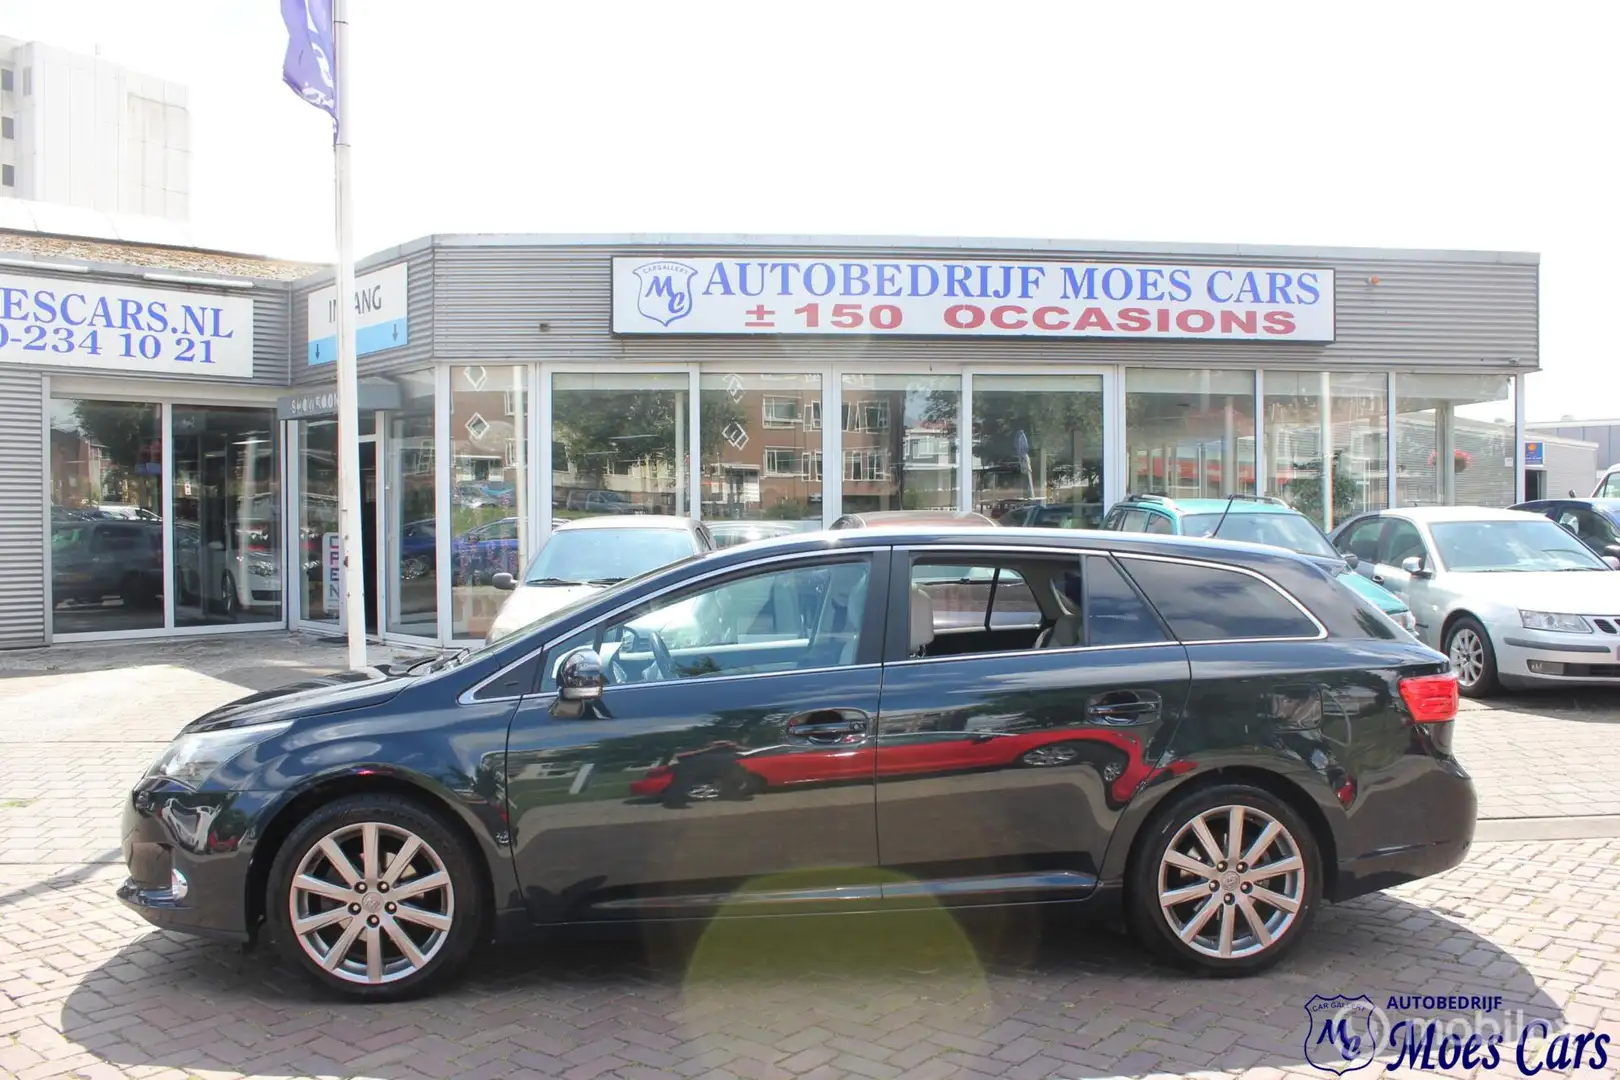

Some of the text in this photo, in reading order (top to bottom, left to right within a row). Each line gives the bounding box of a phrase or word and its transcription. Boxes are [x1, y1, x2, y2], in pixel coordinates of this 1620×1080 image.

[328, 284, 382, 323] IANG
[702, 262, 1321, 306] AUTOBEDRIJF MOES CARS
[0, 287, 233, 338] ESCARS.NL
[943, 304, 1297, 336] OCCASIONS
[119, 333, 161, 360] 10
[174, 337, 216, 364] 21
